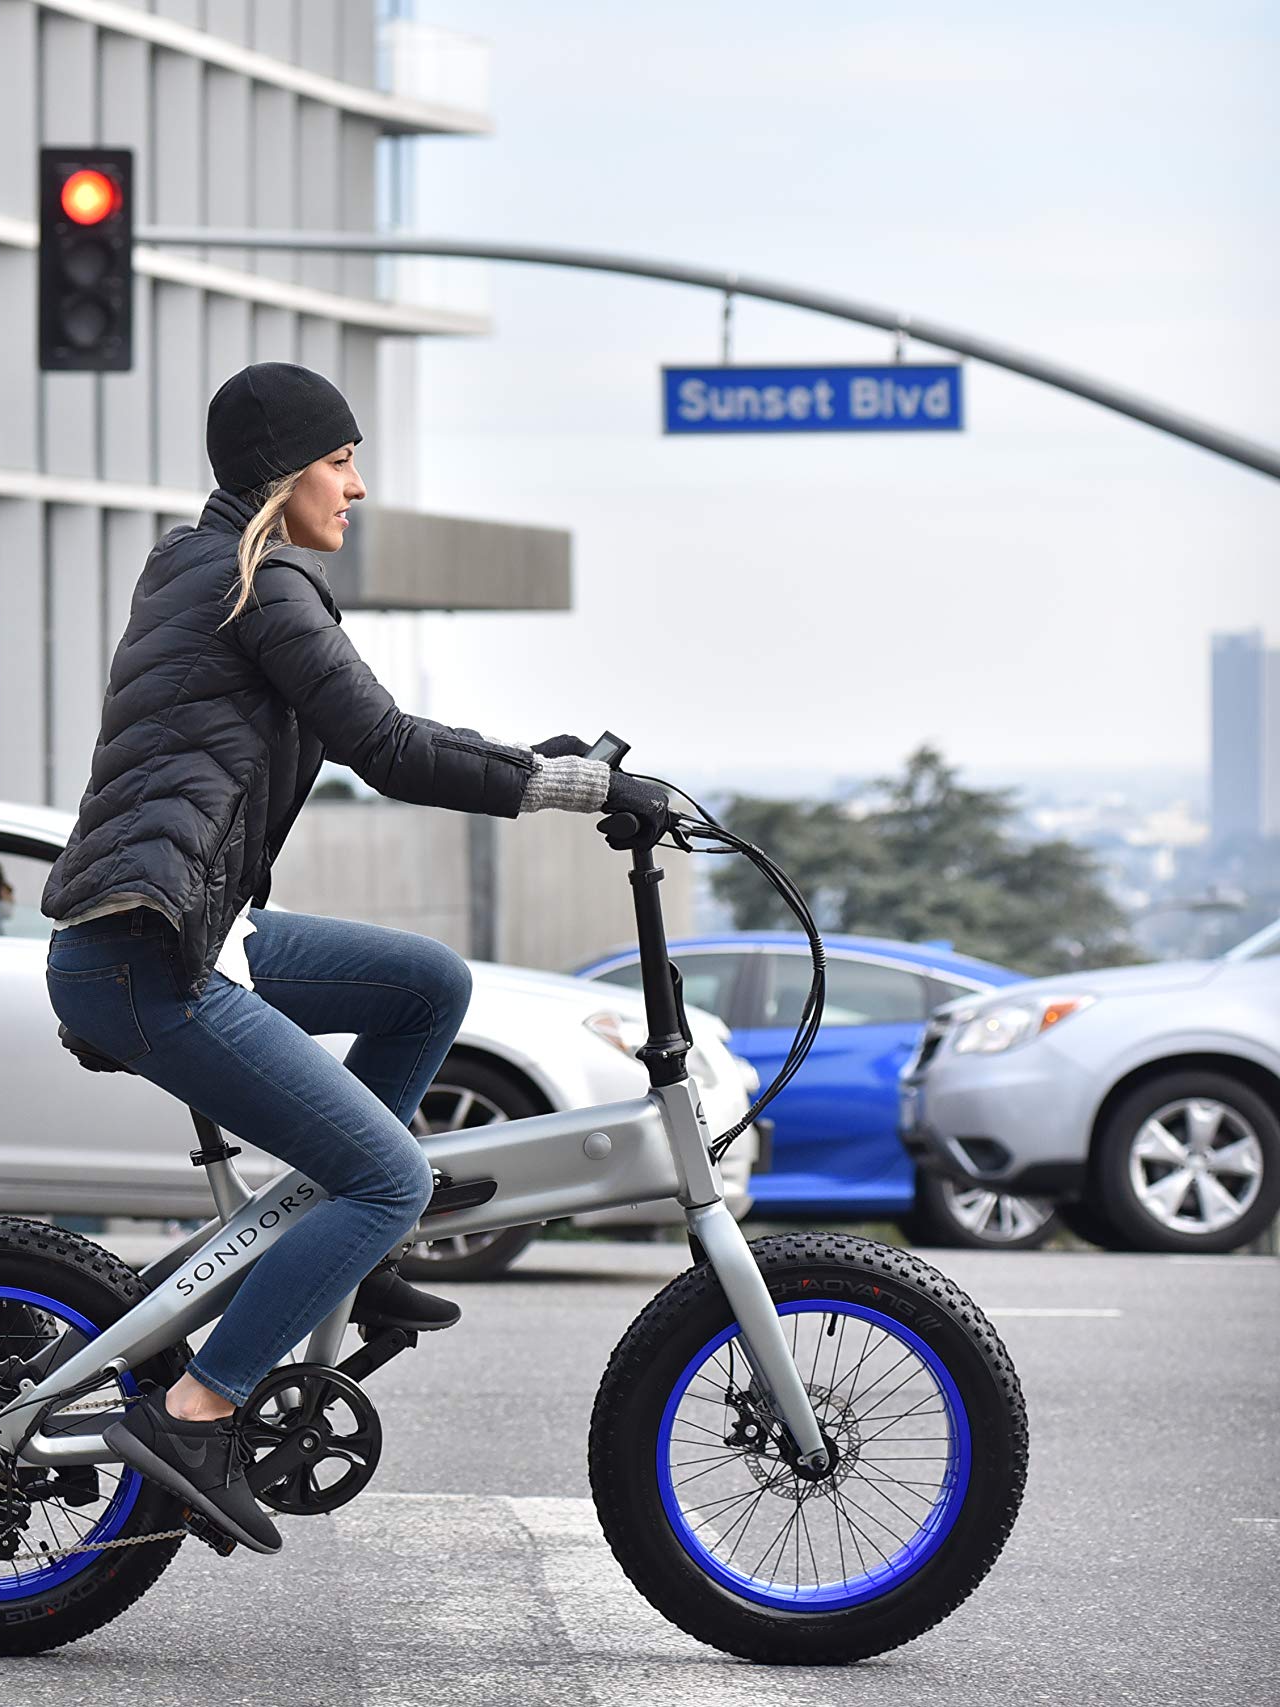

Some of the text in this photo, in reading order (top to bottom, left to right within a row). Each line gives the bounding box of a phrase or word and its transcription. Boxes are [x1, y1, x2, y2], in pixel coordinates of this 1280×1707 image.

[677, 377, 951, 421] Sunset Blvd
[176, 1183, 316, 1296] SONDORS
